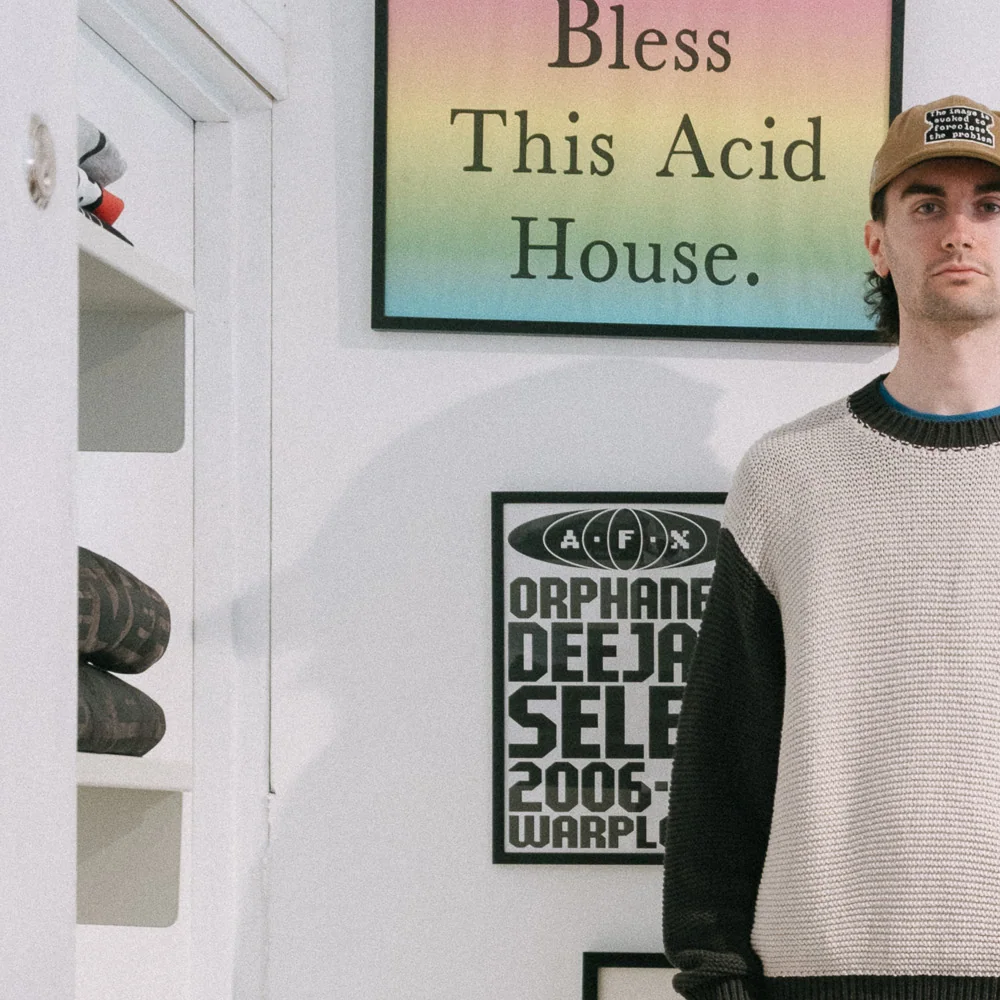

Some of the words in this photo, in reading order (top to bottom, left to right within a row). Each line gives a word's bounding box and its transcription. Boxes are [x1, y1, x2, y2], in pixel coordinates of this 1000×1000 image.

[547, 0, 732, 73] Bless
[934, 115, 969, 123] evoked
[975, 117, 986, 125] to
[949, 108, 977, 116] image
[450, 108, 616, 177] This
[655, 112, 826, 182] Acid
[929, 132, 946, 140] the
[952, 131, 992, 143] problem
[510, 216, 760, 287] House.
[507, 622, 700, 683] DEEJA
[508, 815, 667, 849] WARPL
